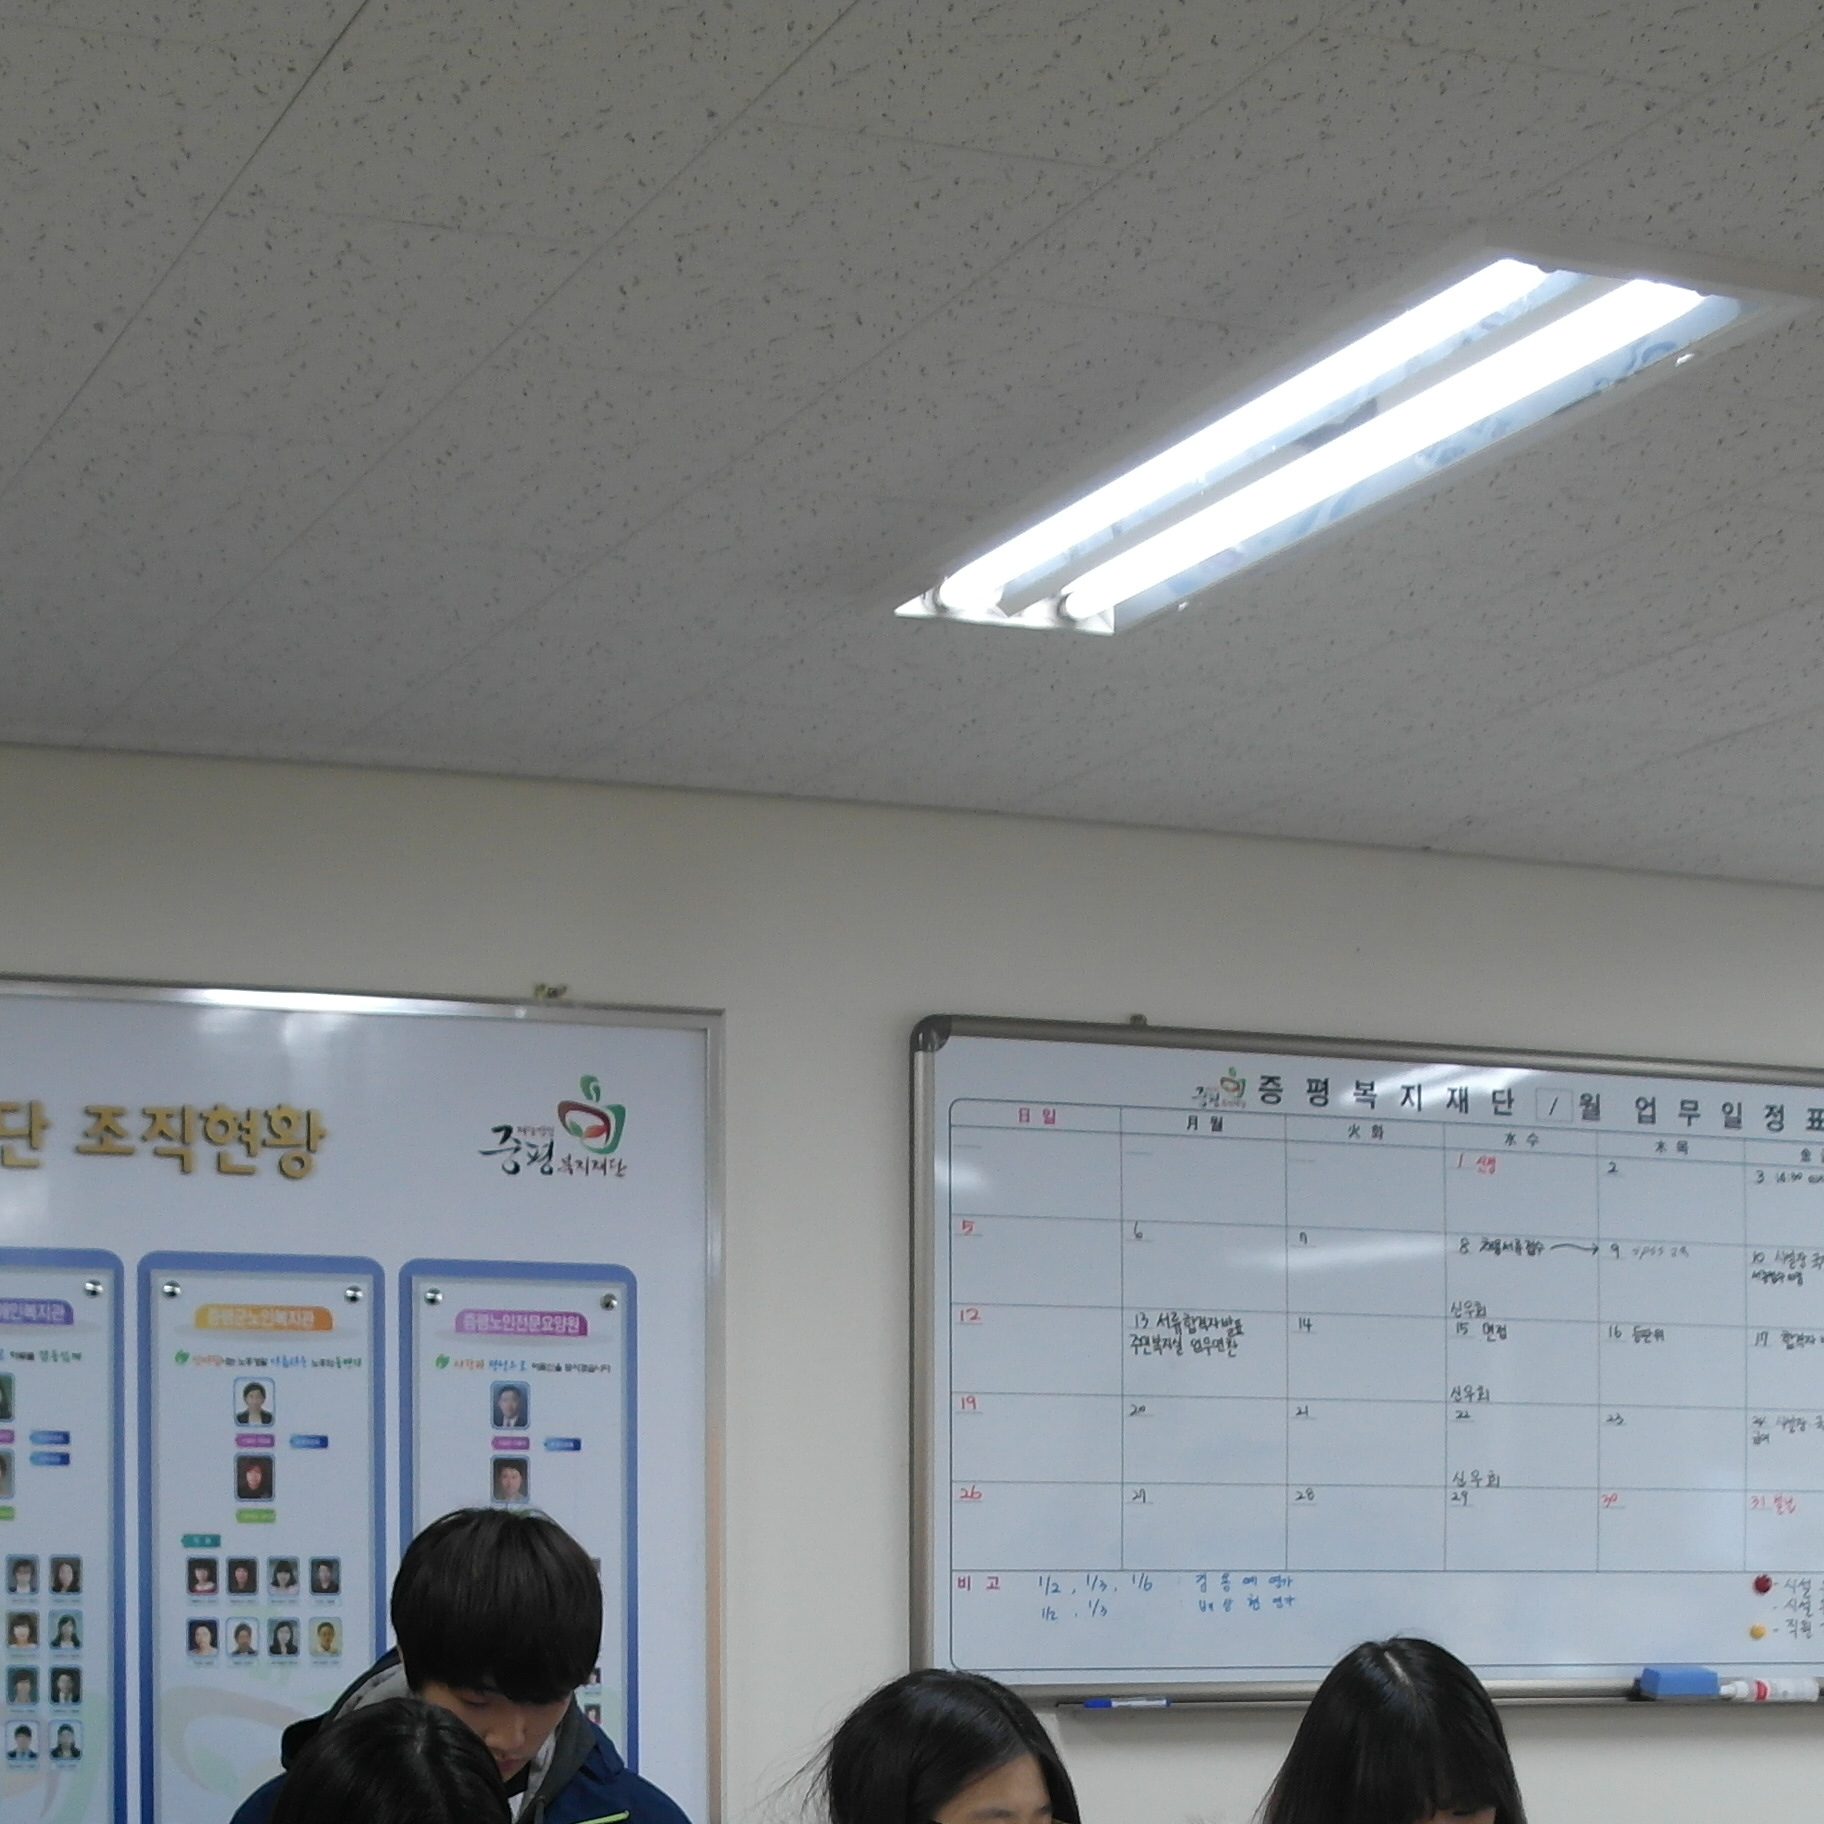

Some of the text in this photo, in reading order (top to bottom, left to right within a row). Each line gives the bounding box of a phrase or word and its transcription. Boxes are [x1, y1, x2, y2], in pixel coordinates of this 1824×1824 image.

[1258, 1075, 1516, 1118] 증평복지재단
[75, 1103, 326, 1180] 조직현황
[1607, 1161, 1618, 1173] 2
[1756, 1170, 1765, 1184] 3
[1459, 1237, 1471, 1254] 8
[1611, 1243, 1620, 1259] 9
[959, 1308, 980, 1322] 12
[1134, 1313, 1149, 1329] 13
[1298, 1317, 1313, 1332] 14
[1456, 1323, 1470, 1335] 15
[1609, 1326, 1623, 1338] 16
[960, 1396, 977, 1411] 19
[1295, 1406, 1310, 1416] 21
[1606, 1413, 1624, 1425] 23
[959, 1485, 983, 1500] 26
[1295, 1488, 1316, 1501] 28
[1451, 1491, 1469, 1506] 29
